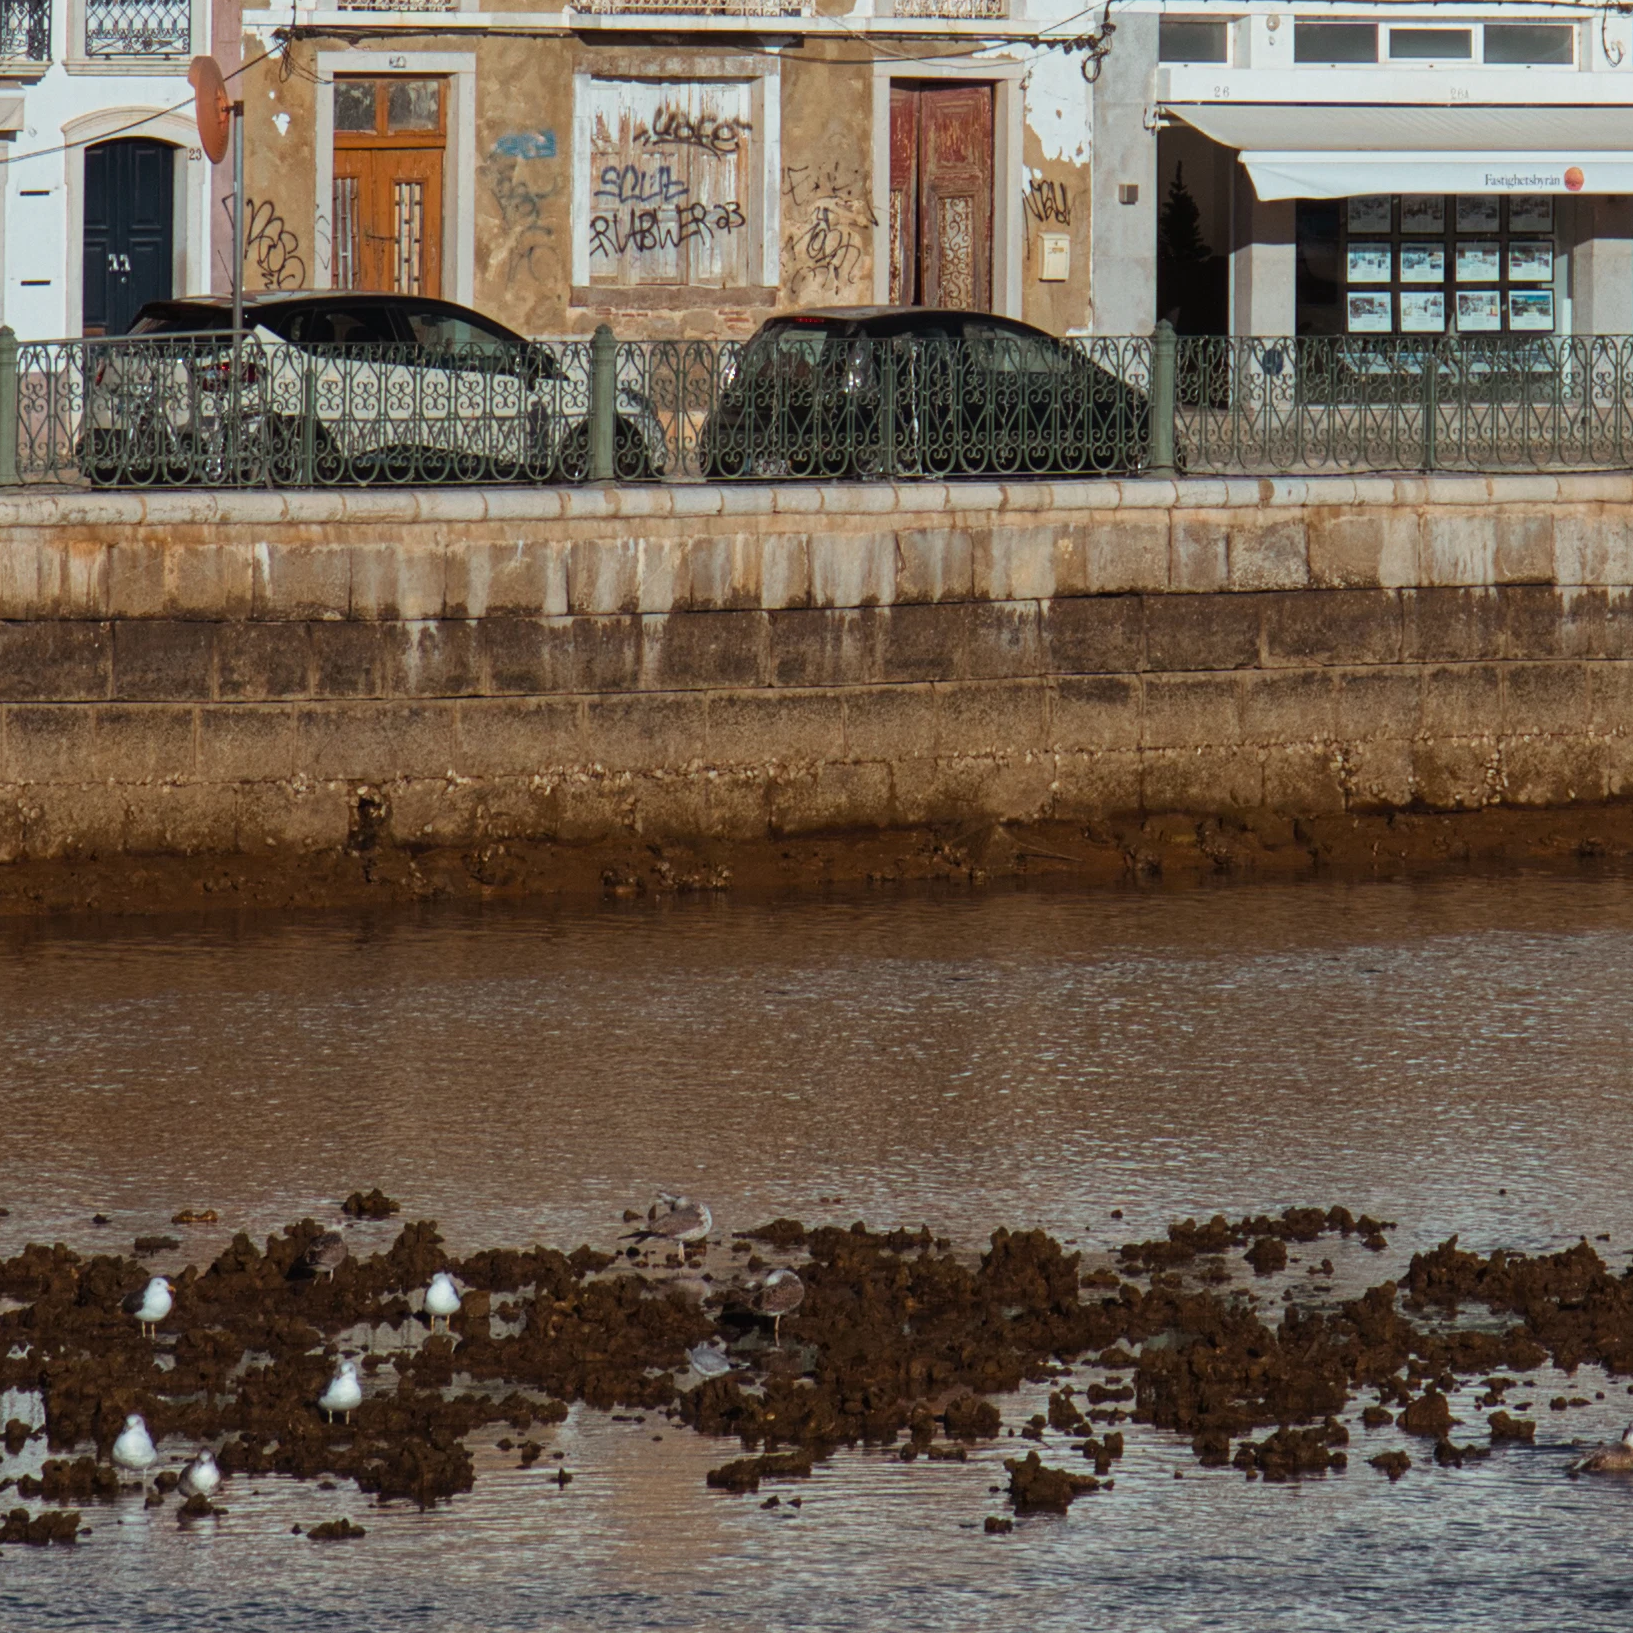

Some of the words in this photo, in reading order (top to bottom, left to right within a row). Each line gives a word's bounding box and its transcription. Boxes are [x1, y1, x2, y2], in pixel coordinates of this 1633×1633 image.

[1213, 85, 1230, 98] 26
[188, 148, 202, 161] 23
[1484, 173, 1561, 190] Fastighetsbyrån
